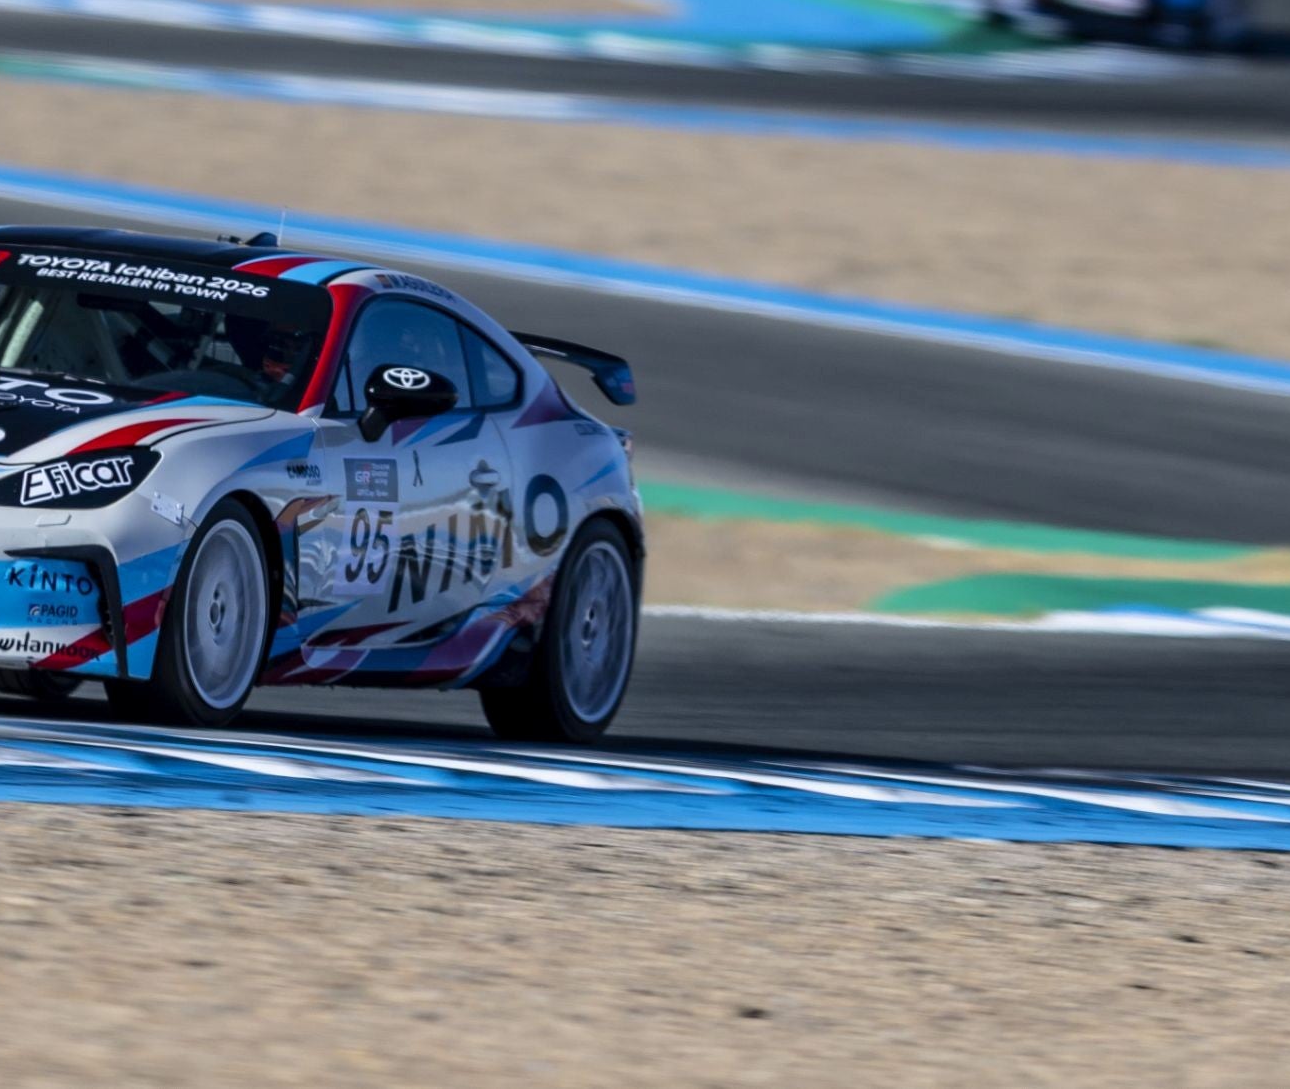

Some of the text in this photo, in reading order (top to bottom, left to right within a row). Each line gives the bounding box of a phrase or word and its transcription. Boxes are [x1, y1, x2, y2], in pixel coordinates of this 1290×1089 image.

[17, 253, 110, 273] TOYOTA
[115, 262, 205, 287] Ichiban
[206, 276, 271, 298] 2026
[36, 267, 78, 279] BEST
[77, 271, 153, 289] RETAILER
[173, 282, 229, 301] TOWN
[355, 471, 370, 483] GR
[345, 507, 393, 585] 95
[388, 474, 568, 614] NIMO
[41, 603, 78, 618] PAGID
